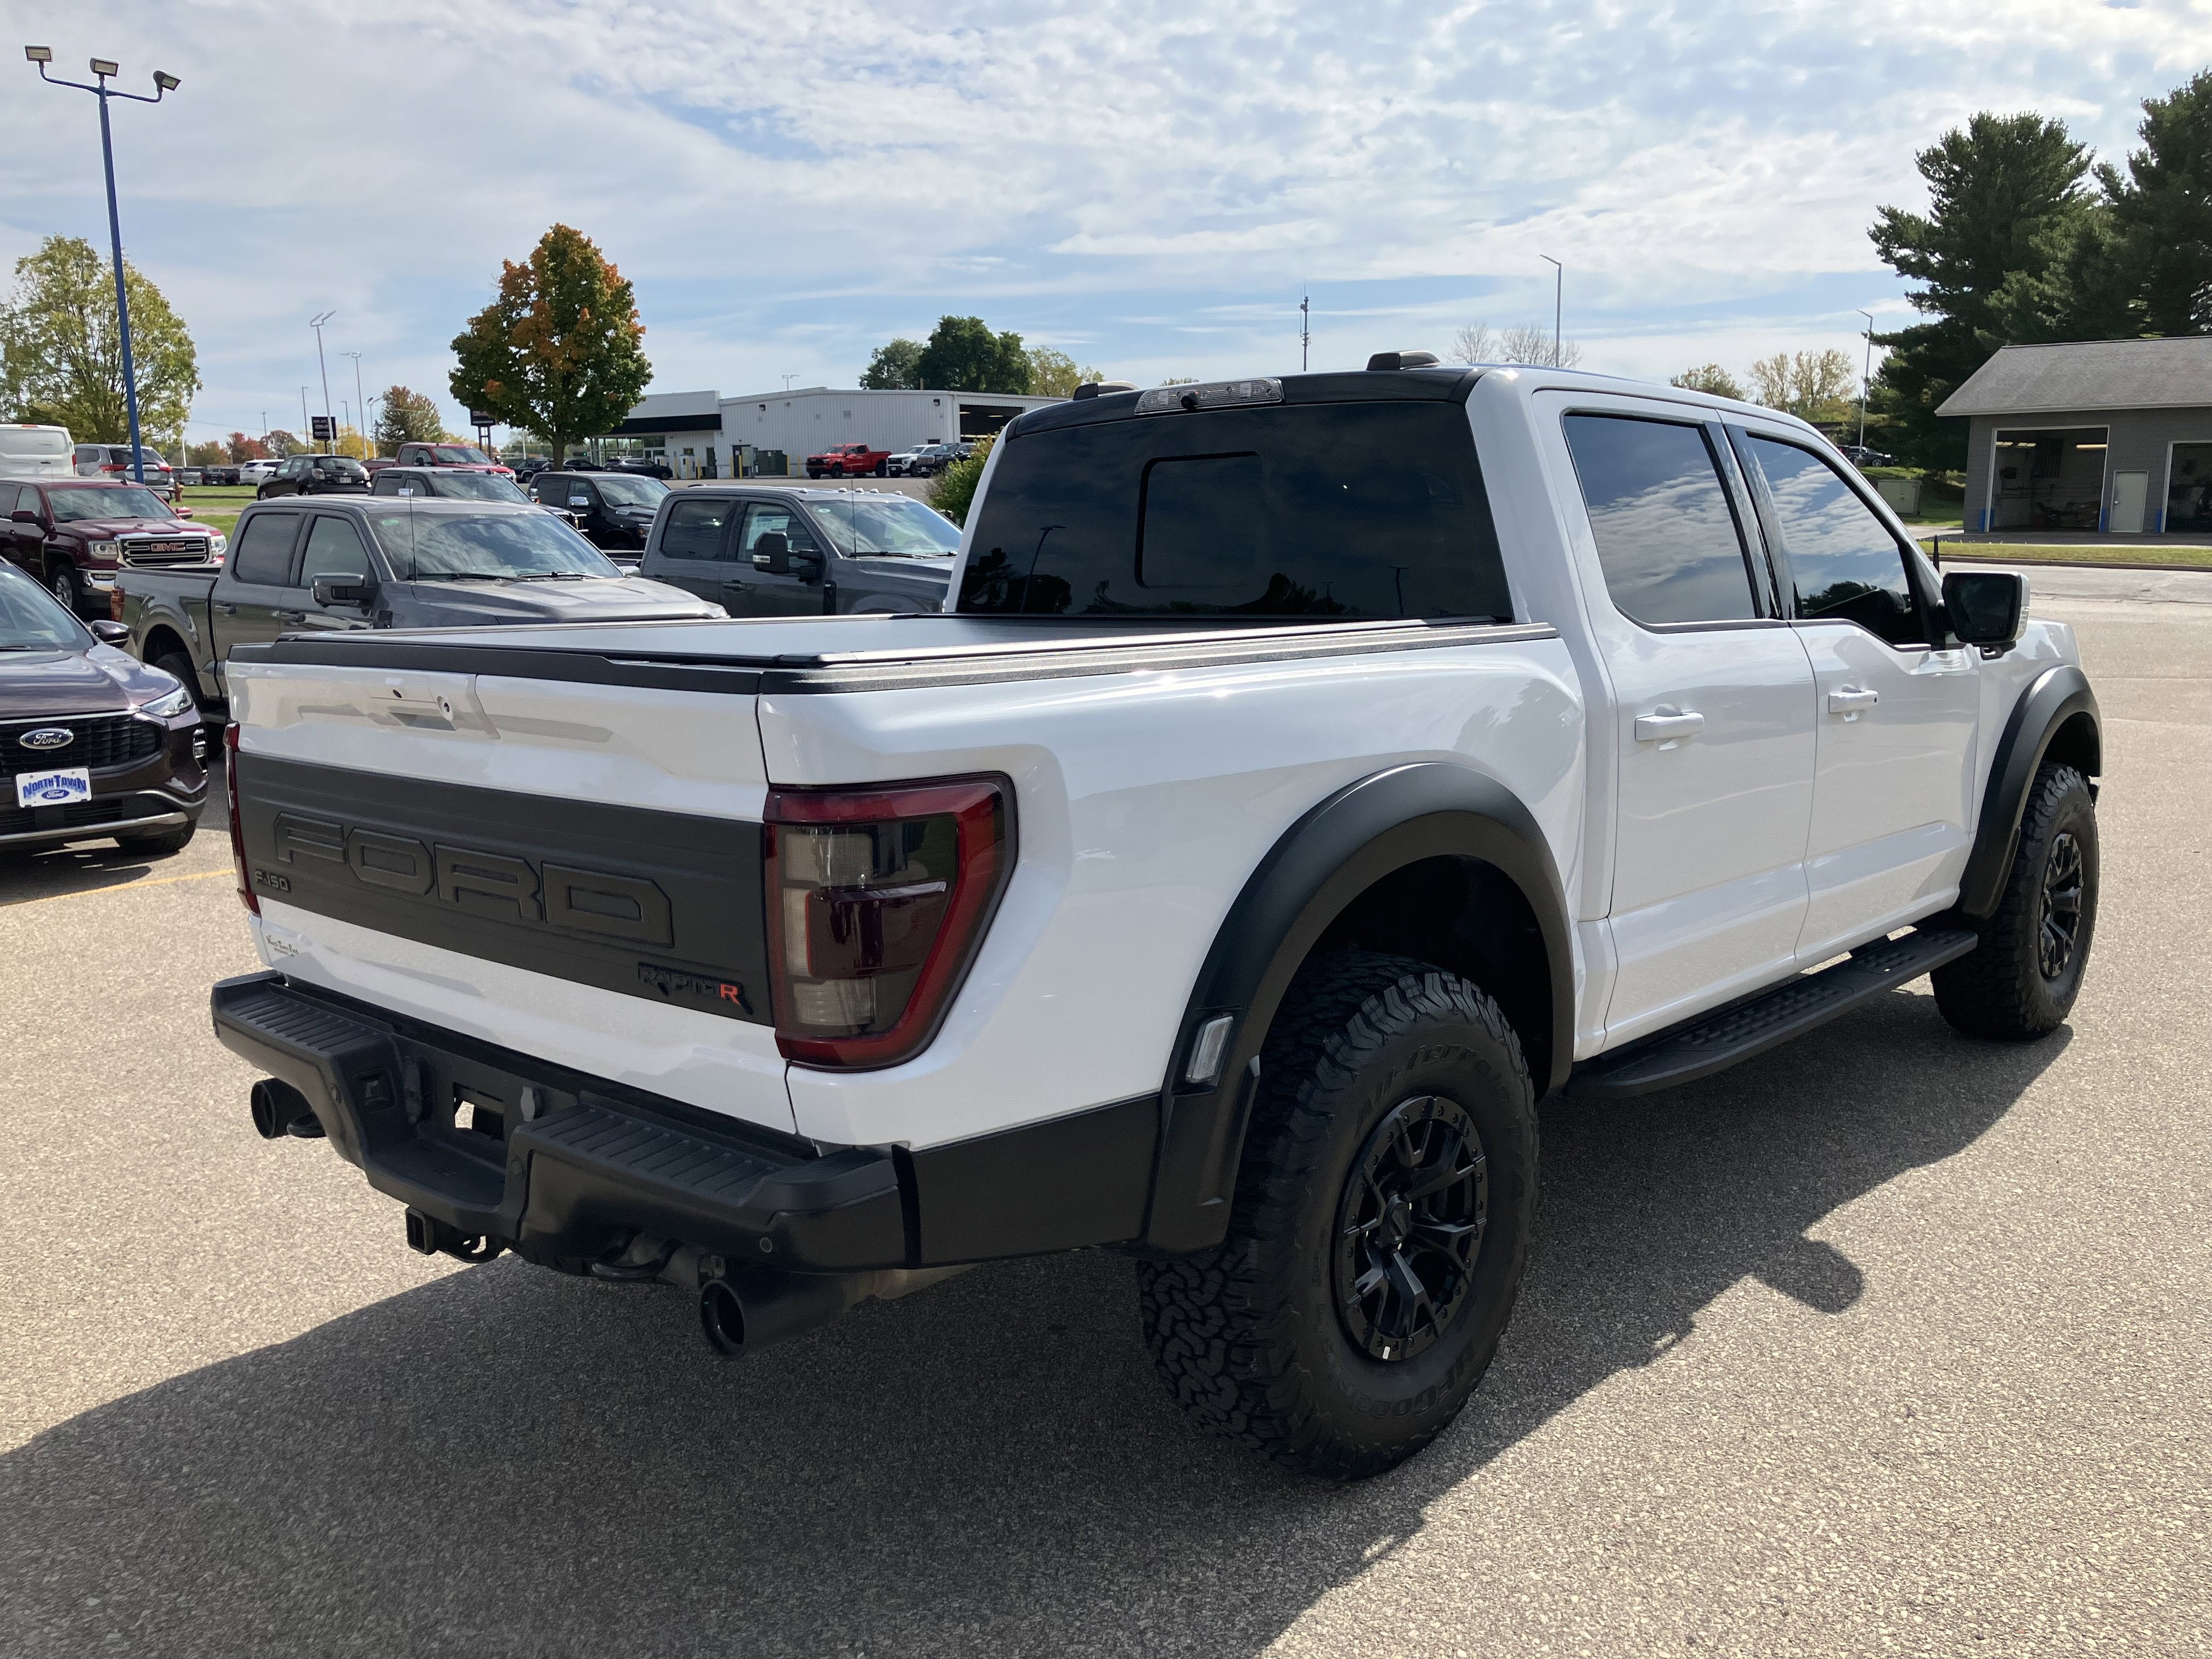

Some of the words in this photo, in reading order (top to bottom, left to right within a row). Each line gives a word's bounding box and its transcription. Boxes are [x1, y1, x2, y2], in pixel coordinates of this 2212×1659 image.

[150, 541, 186, 552] GMC
[33, 732, 62, 746] Ford
[255, 870, 289, 891] F-150
[275, 811, 675, 948] FORD
